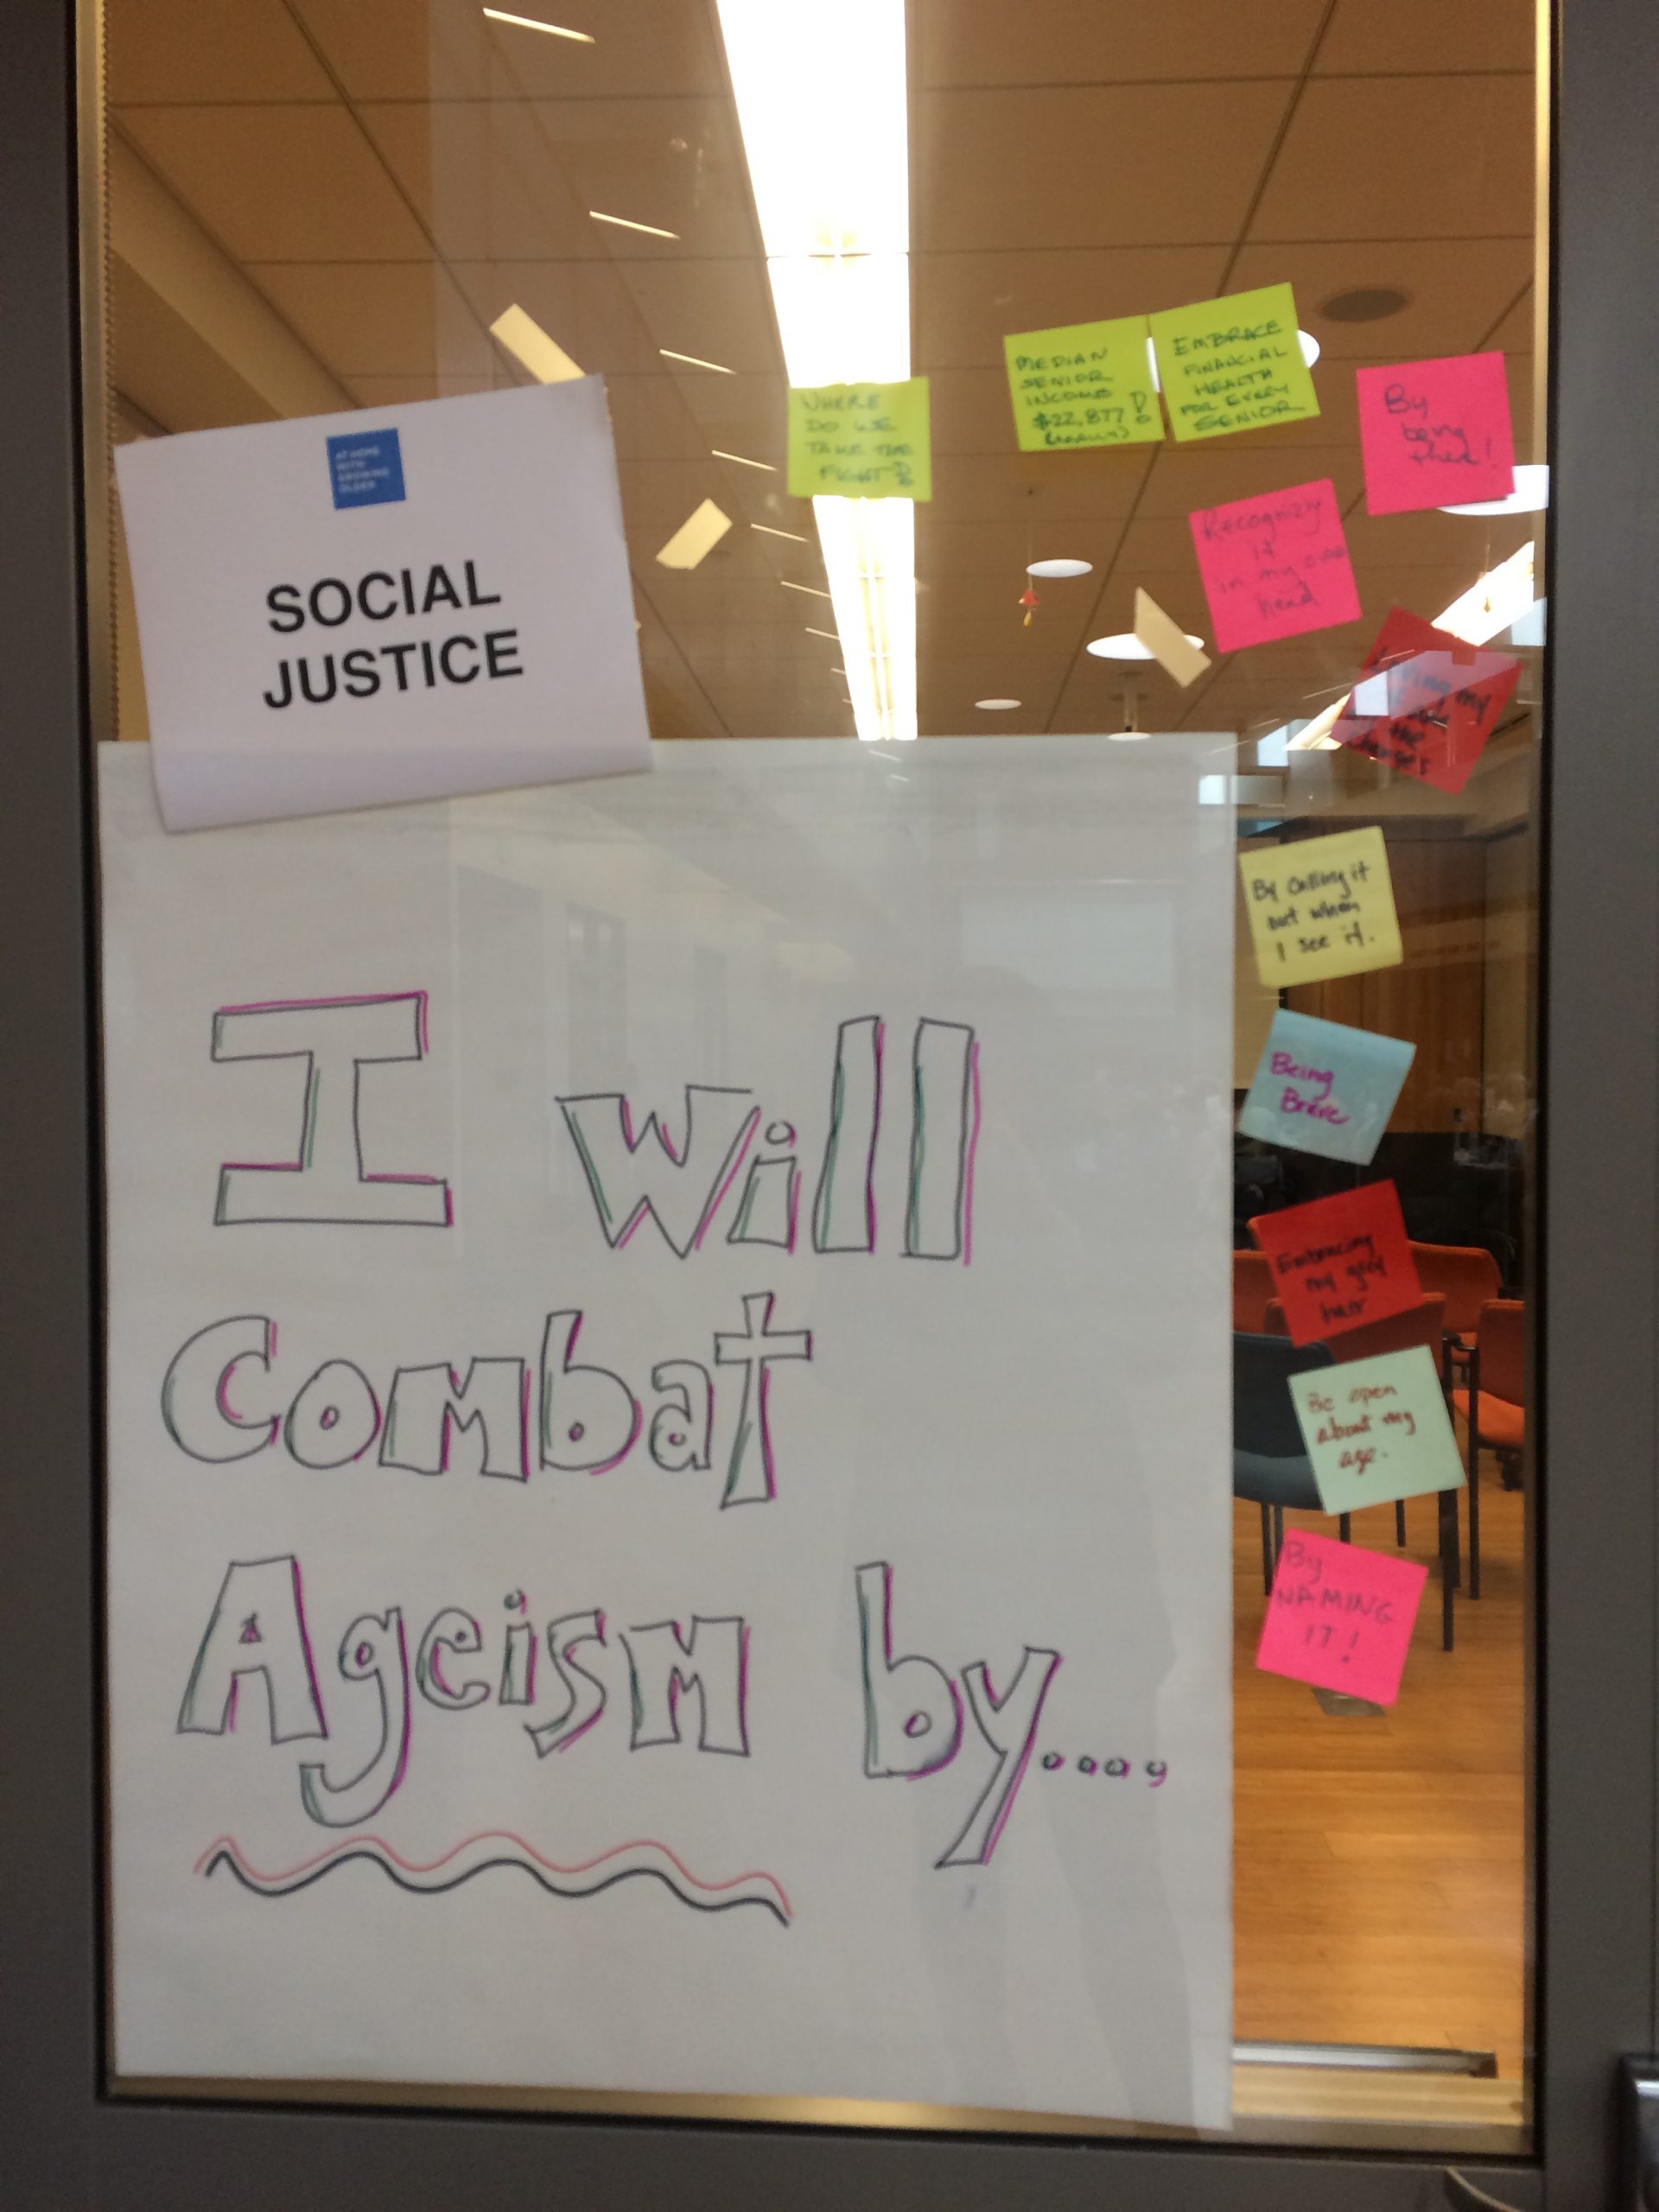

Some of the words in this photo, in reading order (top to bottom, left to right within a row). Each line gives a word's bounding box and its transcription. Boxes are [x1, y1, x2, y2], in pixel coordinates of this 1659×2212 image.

[1173, 319, 1283, 356] EMBRACE
[1014, 347, 1109, 372] MEDIAN
[1183, 346, 1288, 376] FINANCIAL
[1020, 370, 1114, 390] SENIOR
[1026, 388, 1114, 406] INCOME
[1193, 368, 1273, 396] HEALTH
[800, 391, 880, 412] WHERE
[1180, 402, 1217, 416] FOR
[1193, 400, 1306, 432] SENIOR
[1383, 383, 1428, 419] By
[806, 418, 840, 433] DO
[266, 558, 502, 634] SOCIAL
[263, 628, 524, 709] JUSTICE
[1251, 878, 1279, 903] By
[1351, 860, 1371, 883] it
[1275, 940, 1287, 963] I
[1297, 934, 1331, 953] see
[1270, 1051, 1335, 1102] Being
[1280, 1085, 1351, 1126] Brave
[213, 990, 454, 1228] I
[554, 1014, 982, 1268] Will
[1306, 1390, 1334, 1414] Be
[1348, 1384, 1399, 1407] open
[1315, 1413, 1371, 1446] about
[1381, 1410, 1417, 1437] my
[1284, 1540, 1323, 1586] By
[1276, 1585, 1395, 1624] NAMING
[175, 1553, 753, 1828] Ageism
